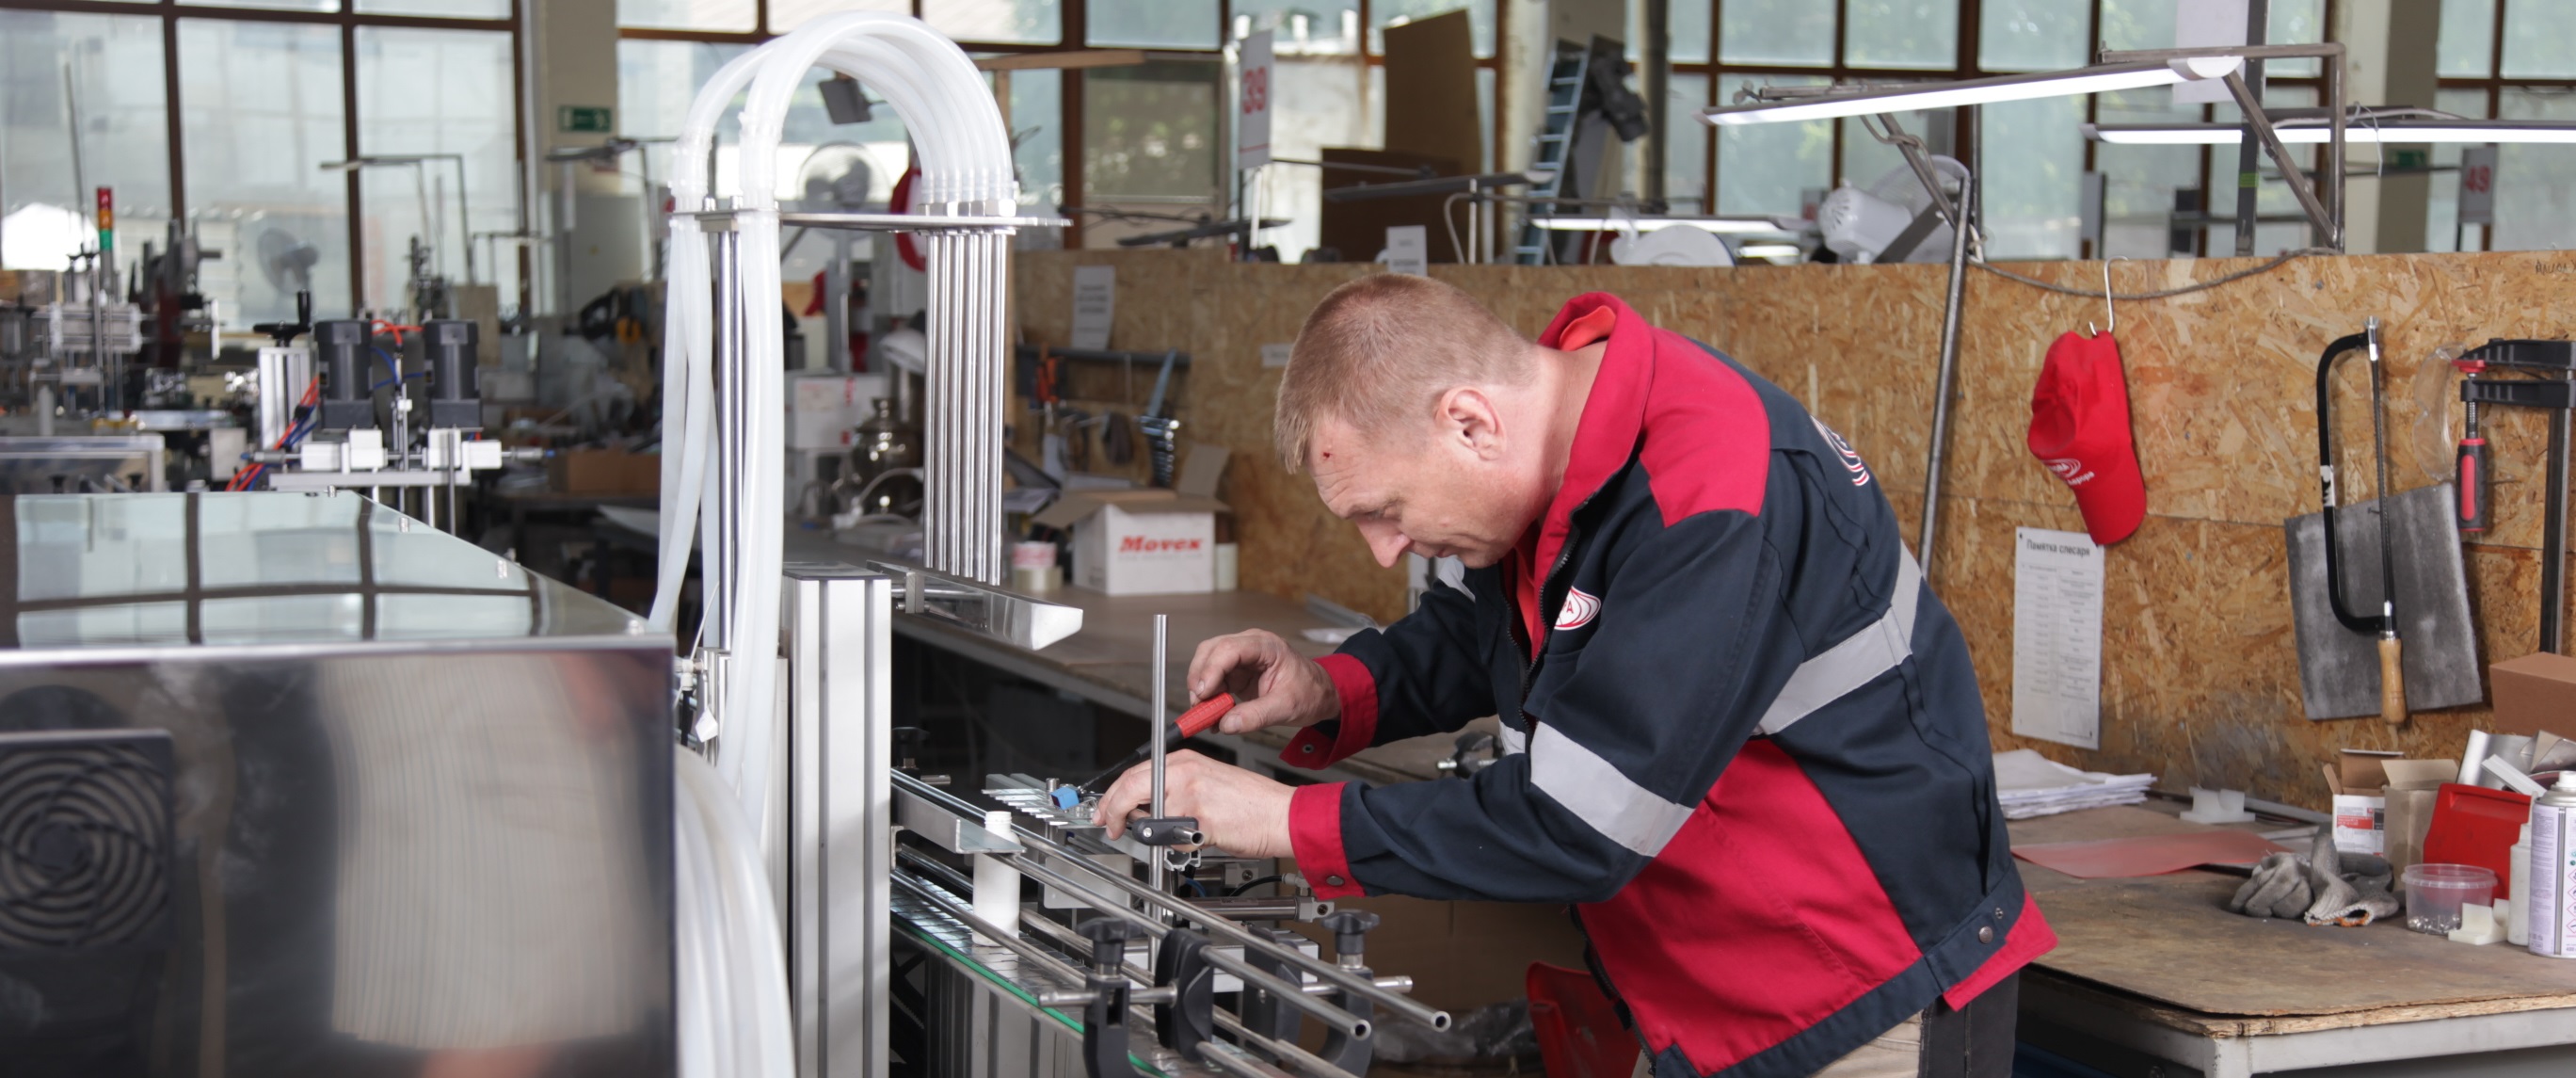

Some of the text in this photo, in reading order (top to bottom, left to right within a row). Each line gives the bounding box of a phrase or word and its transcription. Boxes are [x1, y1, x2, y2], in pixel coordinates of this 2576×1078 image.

[1242, 66, 1267, 115] 39
[1118, 534, 1204, 554] Movex
[2026, 538, 2090, 558] Памятка слесаря
